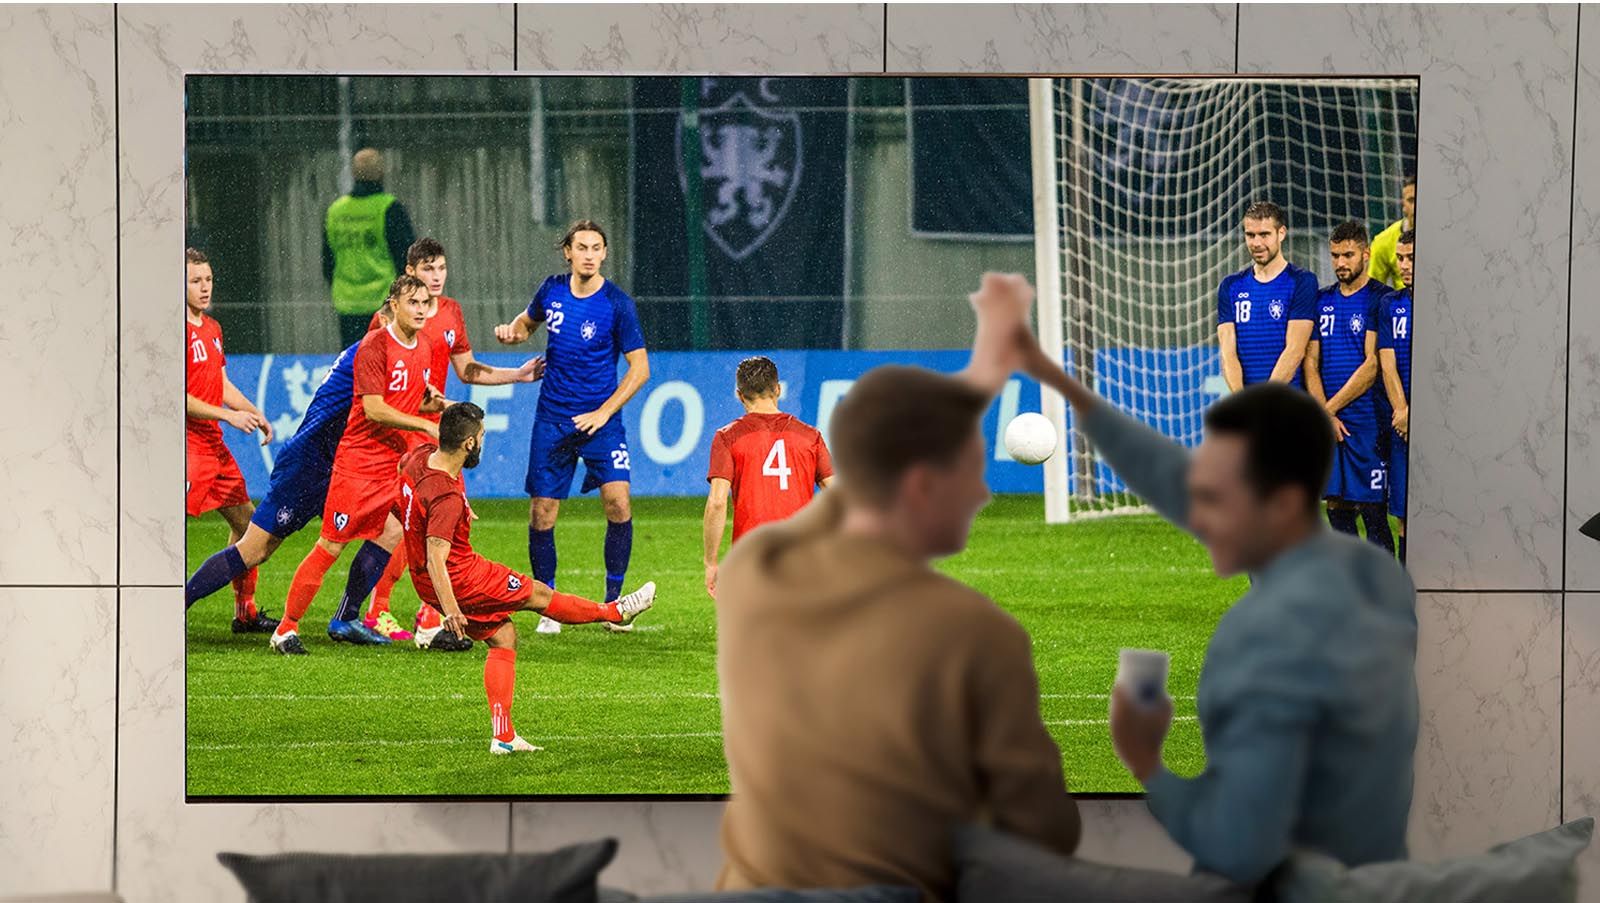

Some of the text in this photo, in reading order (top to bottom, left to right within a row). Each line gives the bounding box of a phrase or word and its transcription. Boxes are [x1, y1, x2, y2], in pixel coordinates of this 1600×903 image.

[545, 309, 565, 334] 22
[1234, 300, 1252, 323] 18
[1319, 314, 1335, 336] 21
[1392, 316, 1408, 339] 14
[191, 339, 208, 363] 10
[388, 369, 408, 391] 21
[762, 438, 792, 490] 4
